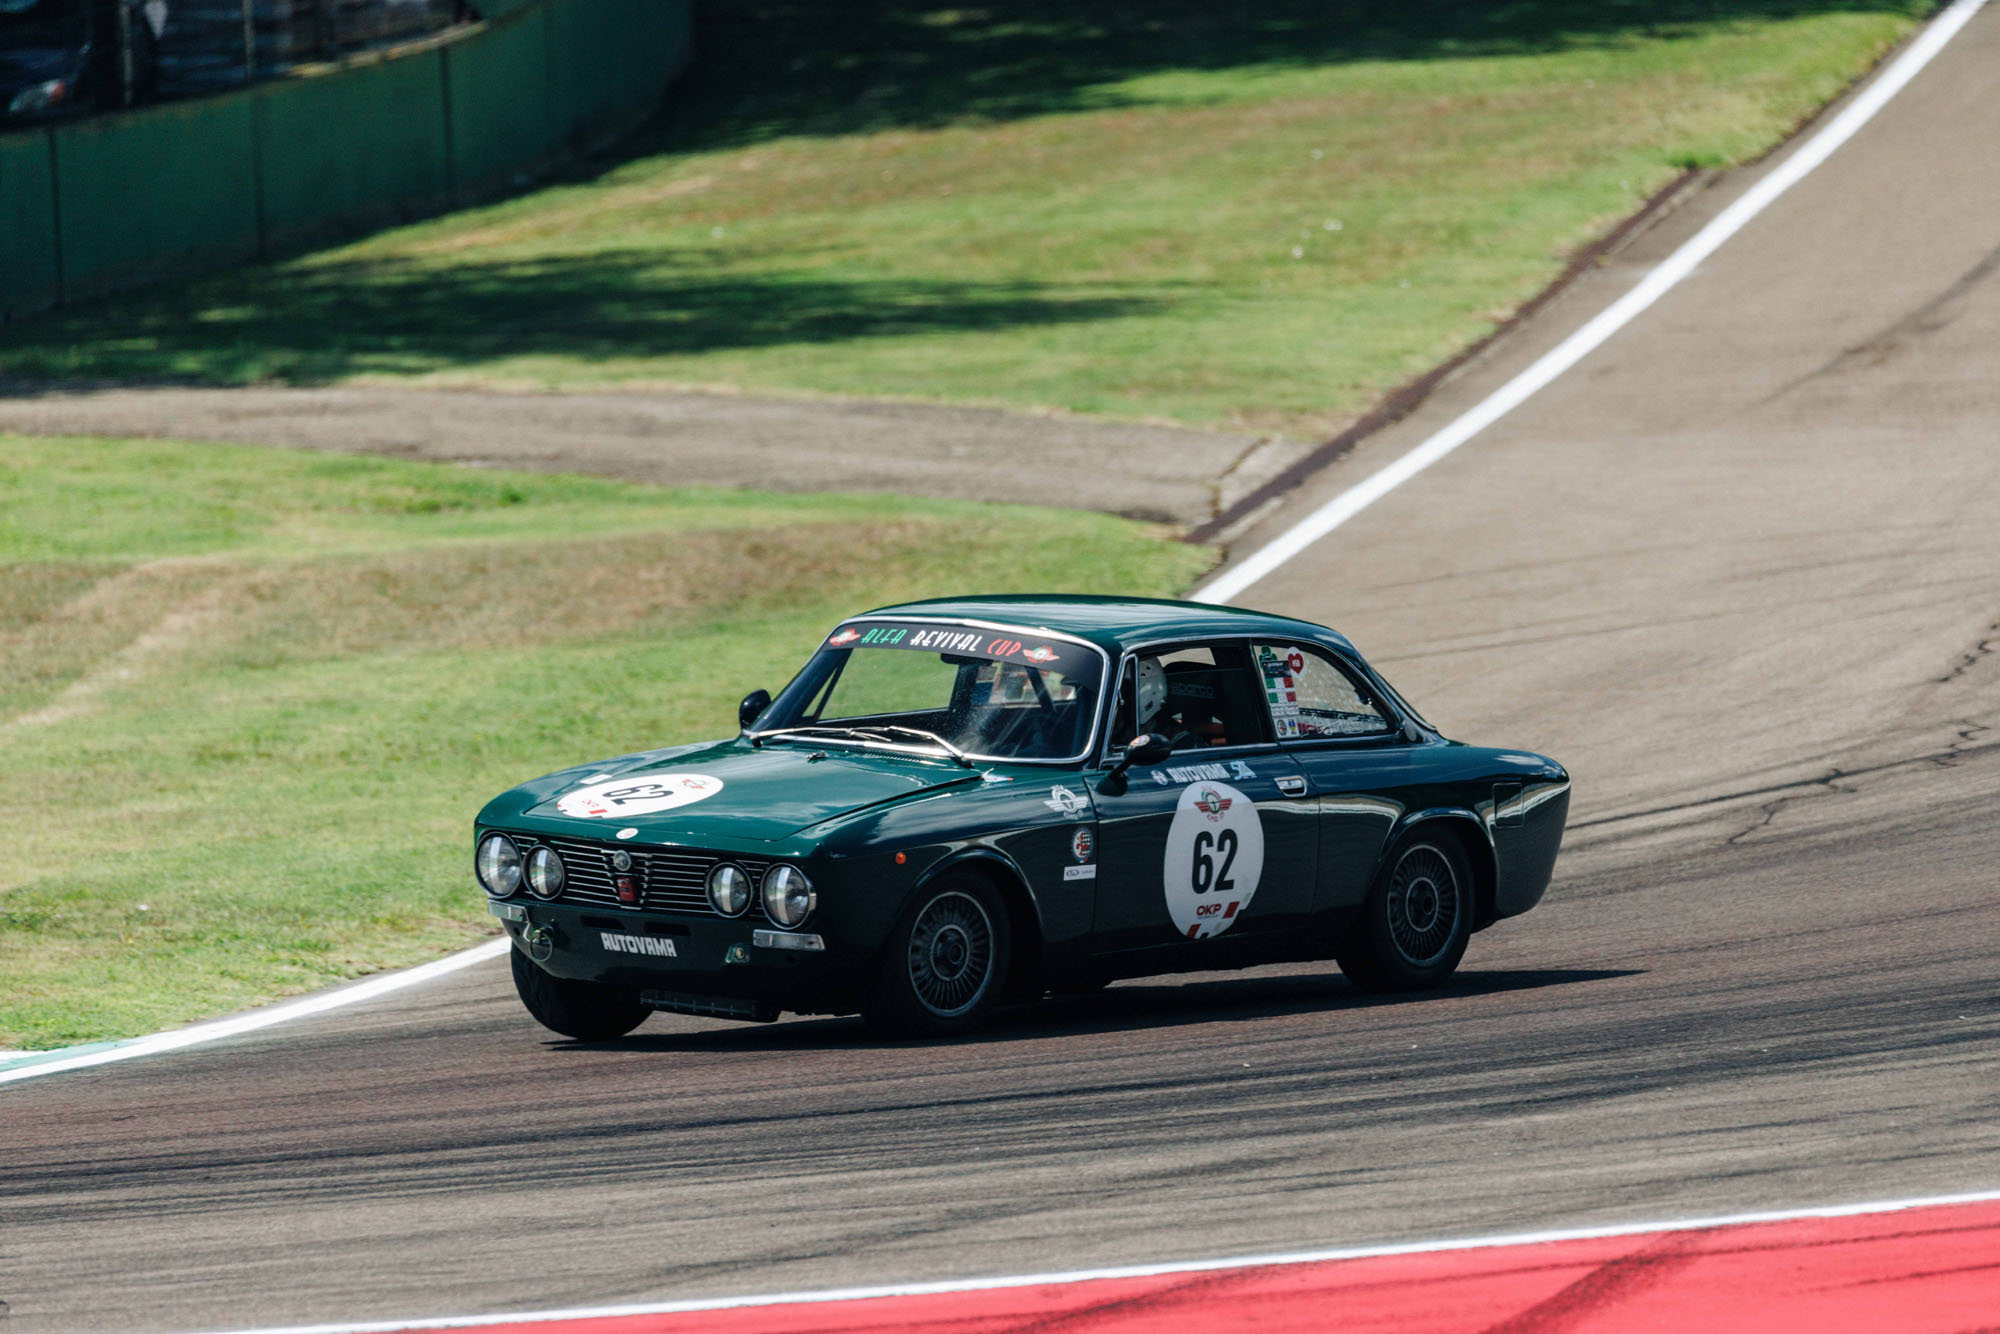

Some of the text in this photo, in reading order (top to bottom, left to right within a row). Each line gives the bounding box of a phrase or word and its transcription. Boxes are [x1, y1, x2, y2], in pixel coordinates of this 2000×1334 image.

[861, 628, 1023, 657] ALFA REVIVAL CUP
[1166, 763, 1231, 784] AUTOVAMA
[602, 784, 674, 806] 62
[1192, 828, 1238, 894] 62
[1197, 903, 1222, 915] OKP
[600, 932, 677, 957] AUTOVAMA
